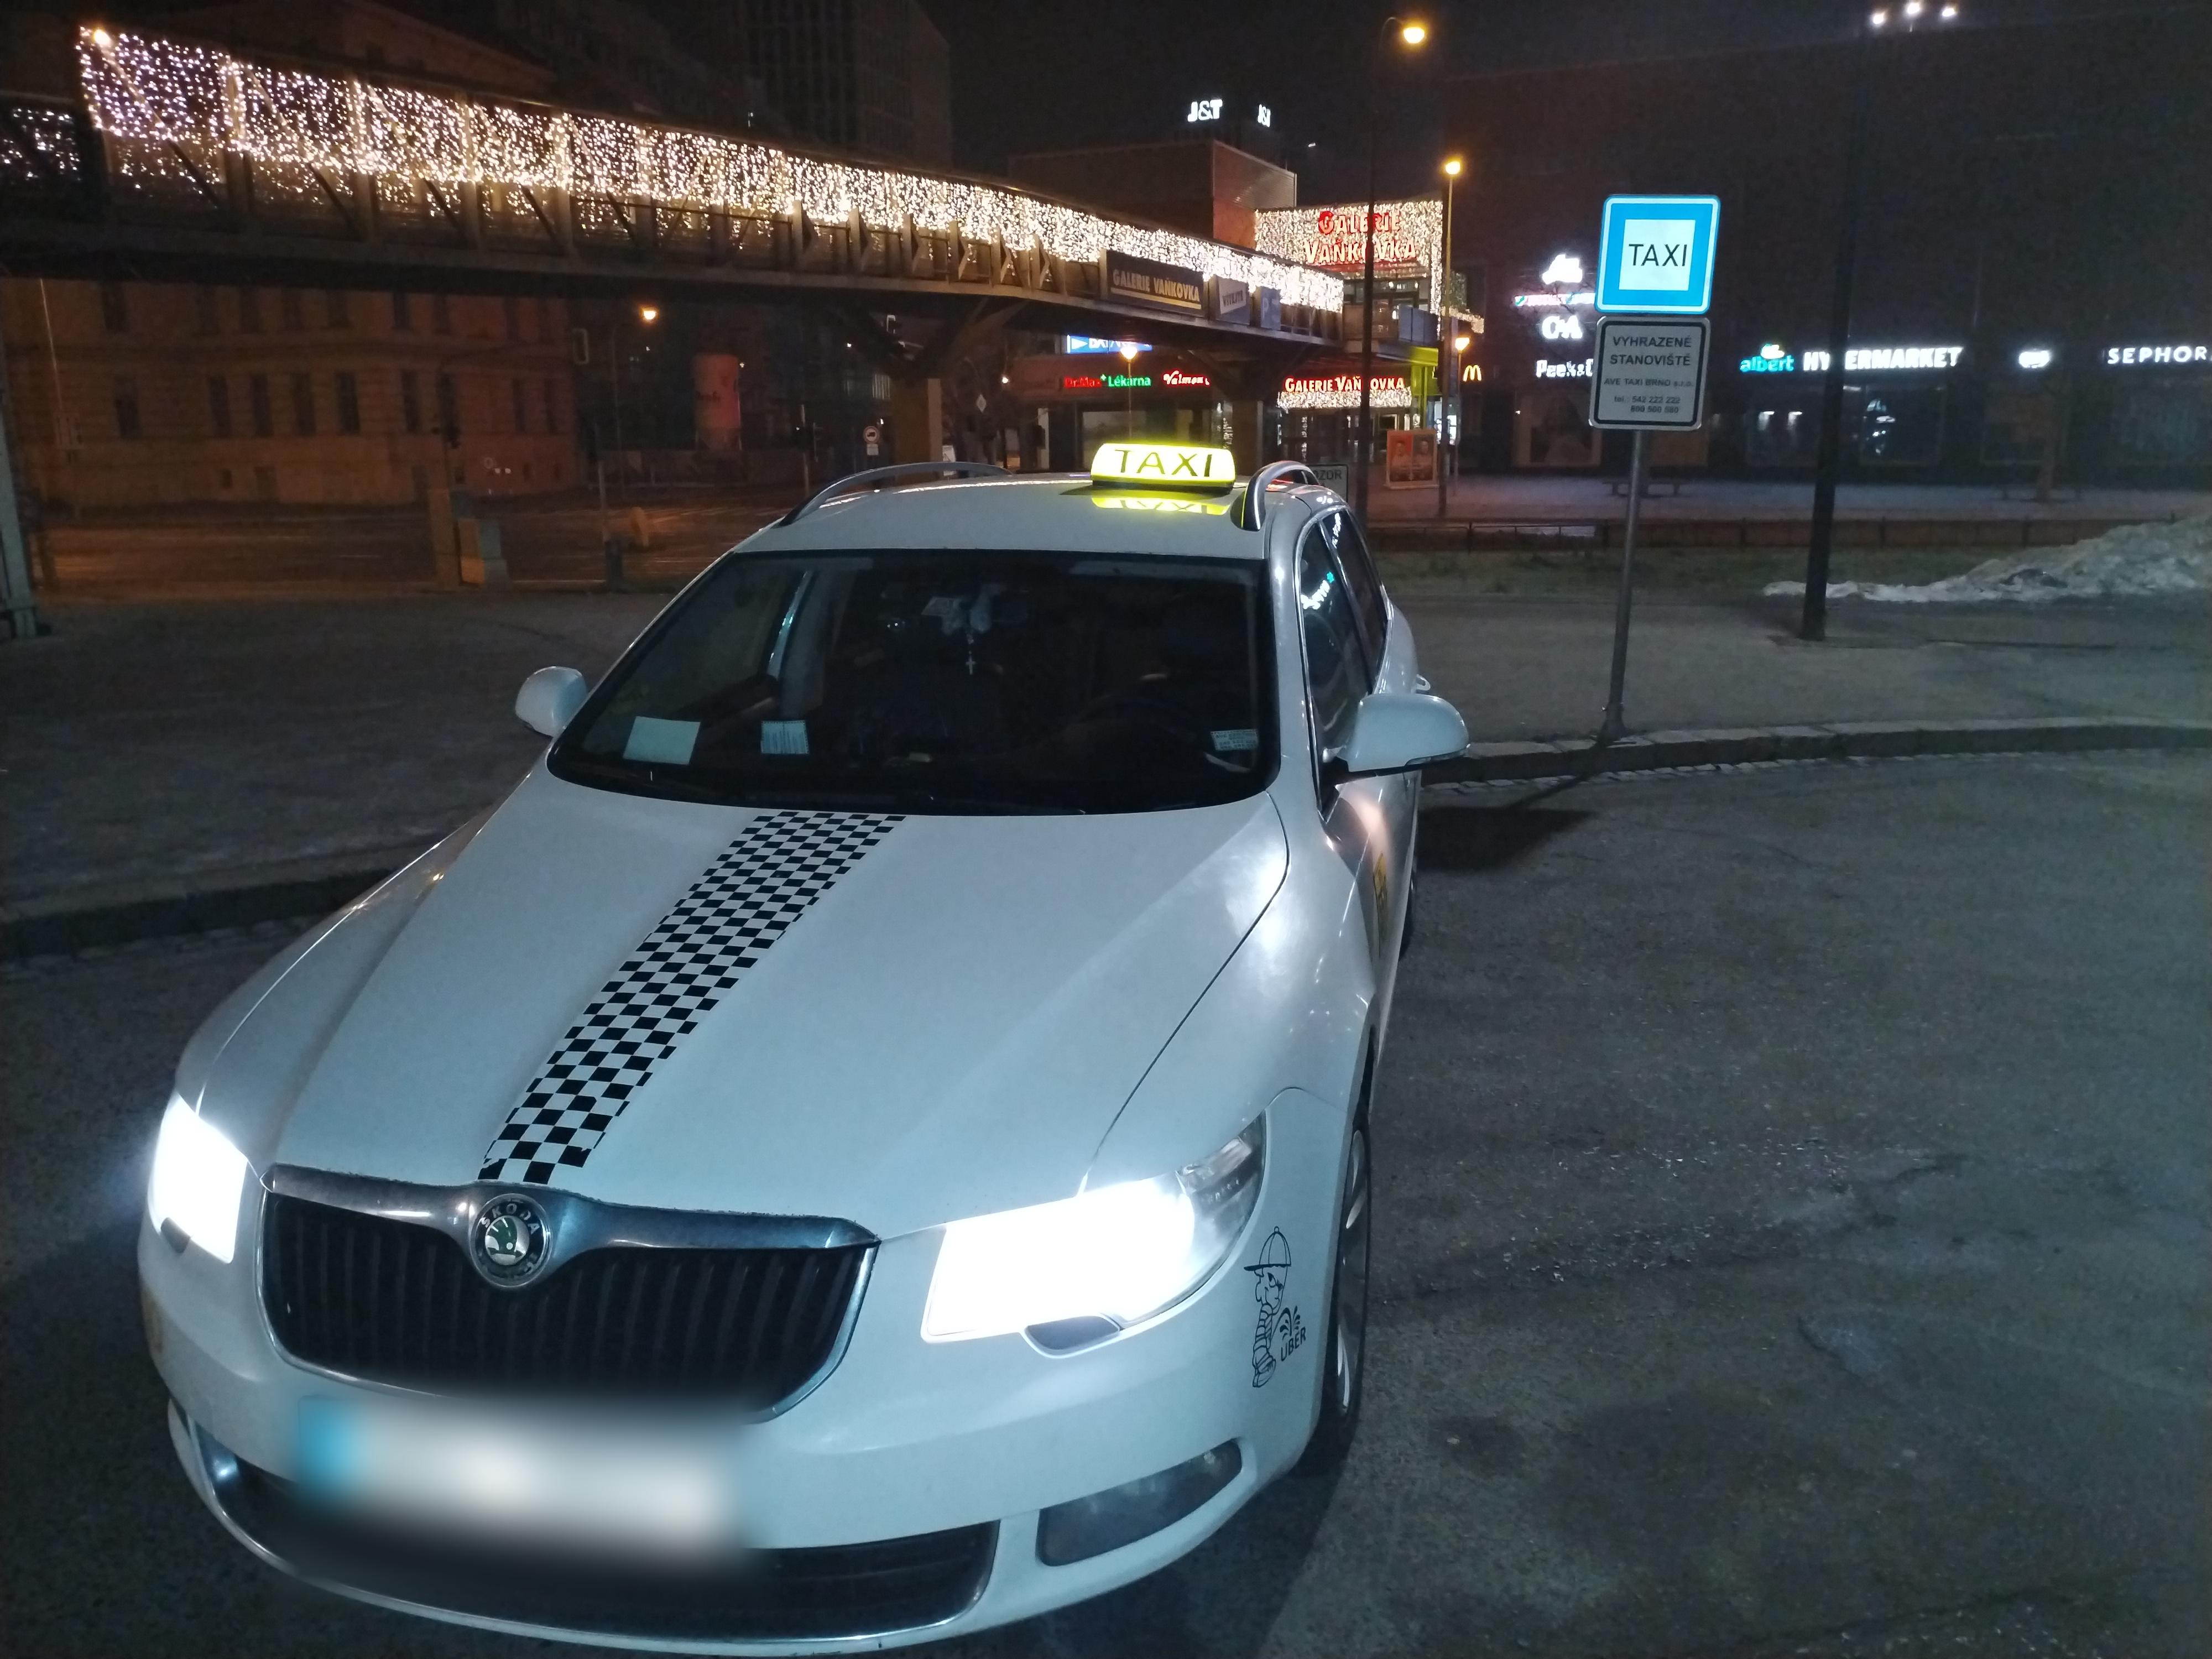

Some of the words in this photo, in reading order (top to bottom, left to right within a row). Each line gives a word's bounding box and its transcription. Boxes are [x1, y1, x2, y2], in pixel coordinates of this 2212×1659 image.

[1187, 99, 1223, 122] J&T
[1629, 244, 1688, 267] TAXI
[1113, 269, 1150, 292] GALERIE
[1154, 277, 1200, 302] VAŇKOVKA
[1613, 335, 1692, 347] VYHRAZENÉ
[1610, 353, 1691, 366] STANOVIŠTĚ
[1740, 354, 1794, 372] albert
[1803, 347, 1963, 371] HYERMARKET
[2107, 346, 2212, 364] SEPHOR
[1285, 378, 1333, 393] GALERIE
[1334, 376, 1405, 392] VAŇOVKA
[1115, 450, 1213, 477] TAXI
[1313, 469, 1342, 481] OZOR
[1281, 1327, 1306, 1361] UBER
